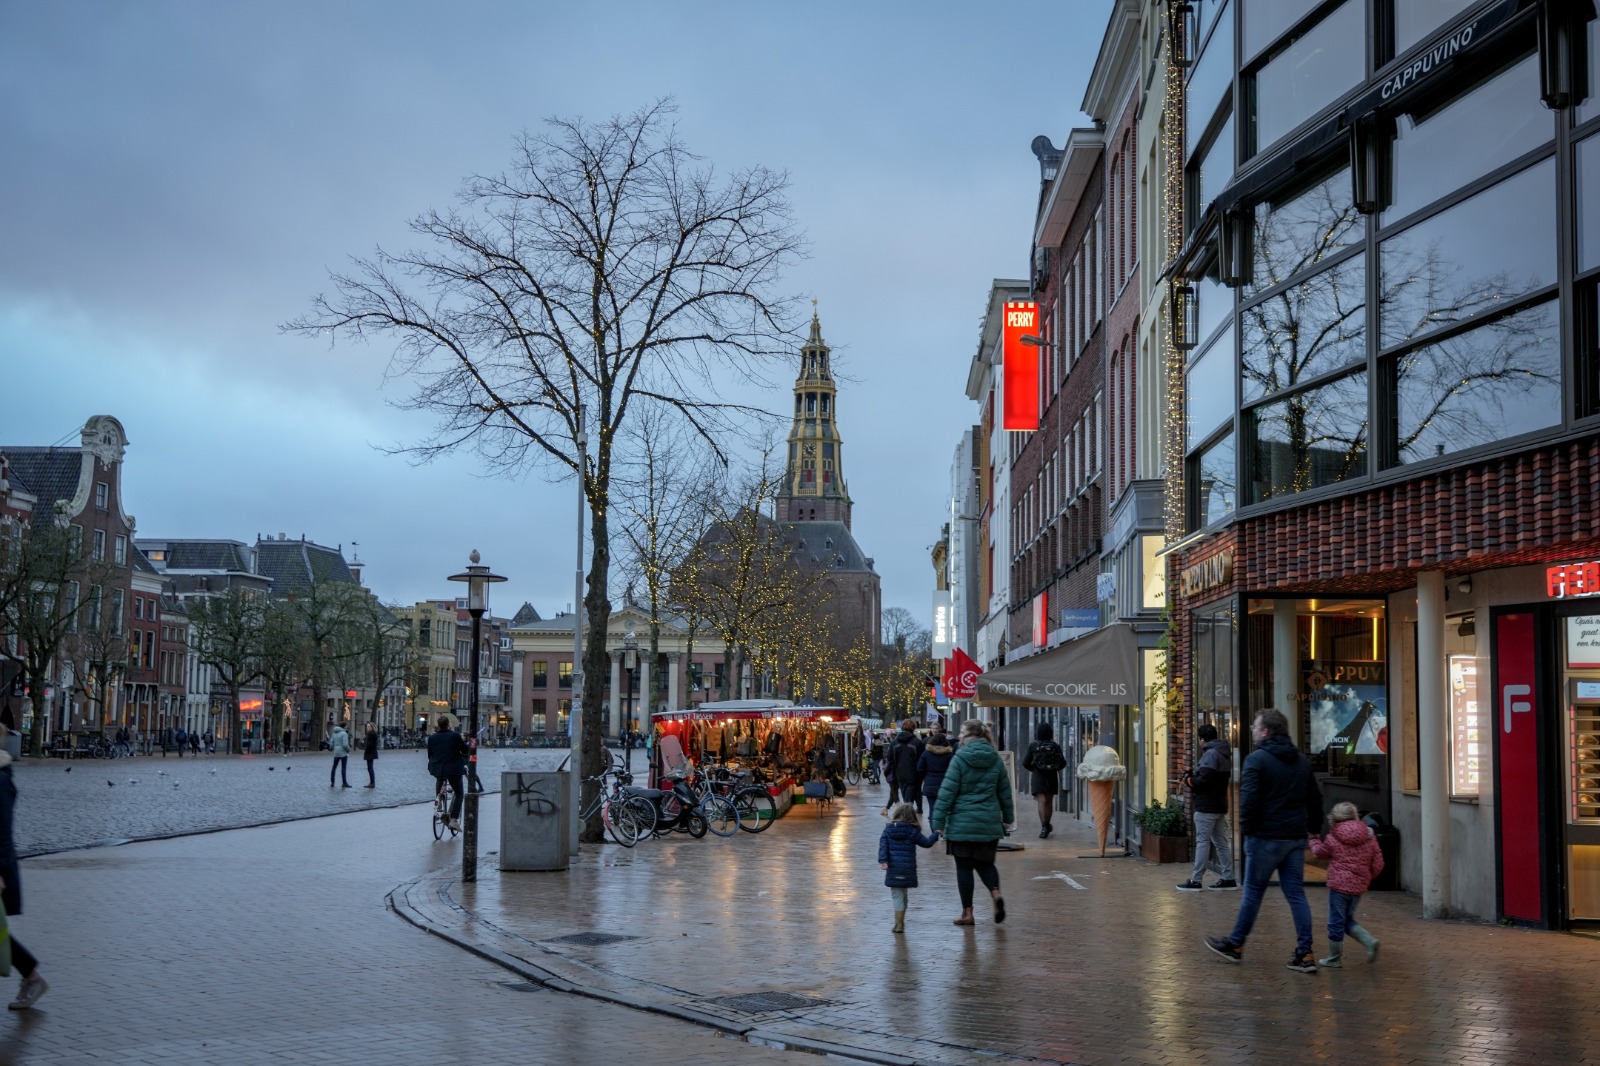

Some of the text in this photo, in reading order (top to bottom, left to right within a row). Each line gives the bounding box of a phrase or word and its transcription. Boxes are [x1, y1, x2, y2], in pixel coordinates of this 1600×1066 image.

[1381, 26, 1474, 99] CAPPUVINO
[1007, 311, 1034, 327] PERRY
[1575, 616, 1594, 626] Opa's
[1581, 628, 1599, 639] gaat
[988, 683, 1033, 695] KOFFIE
[1045, 683, 1097, 696] COOKIE
[1110, 683, 1127, 696] IJS
[793, 710, 813, 718] TASSEN
[1503, 684, 1532, 734] F
